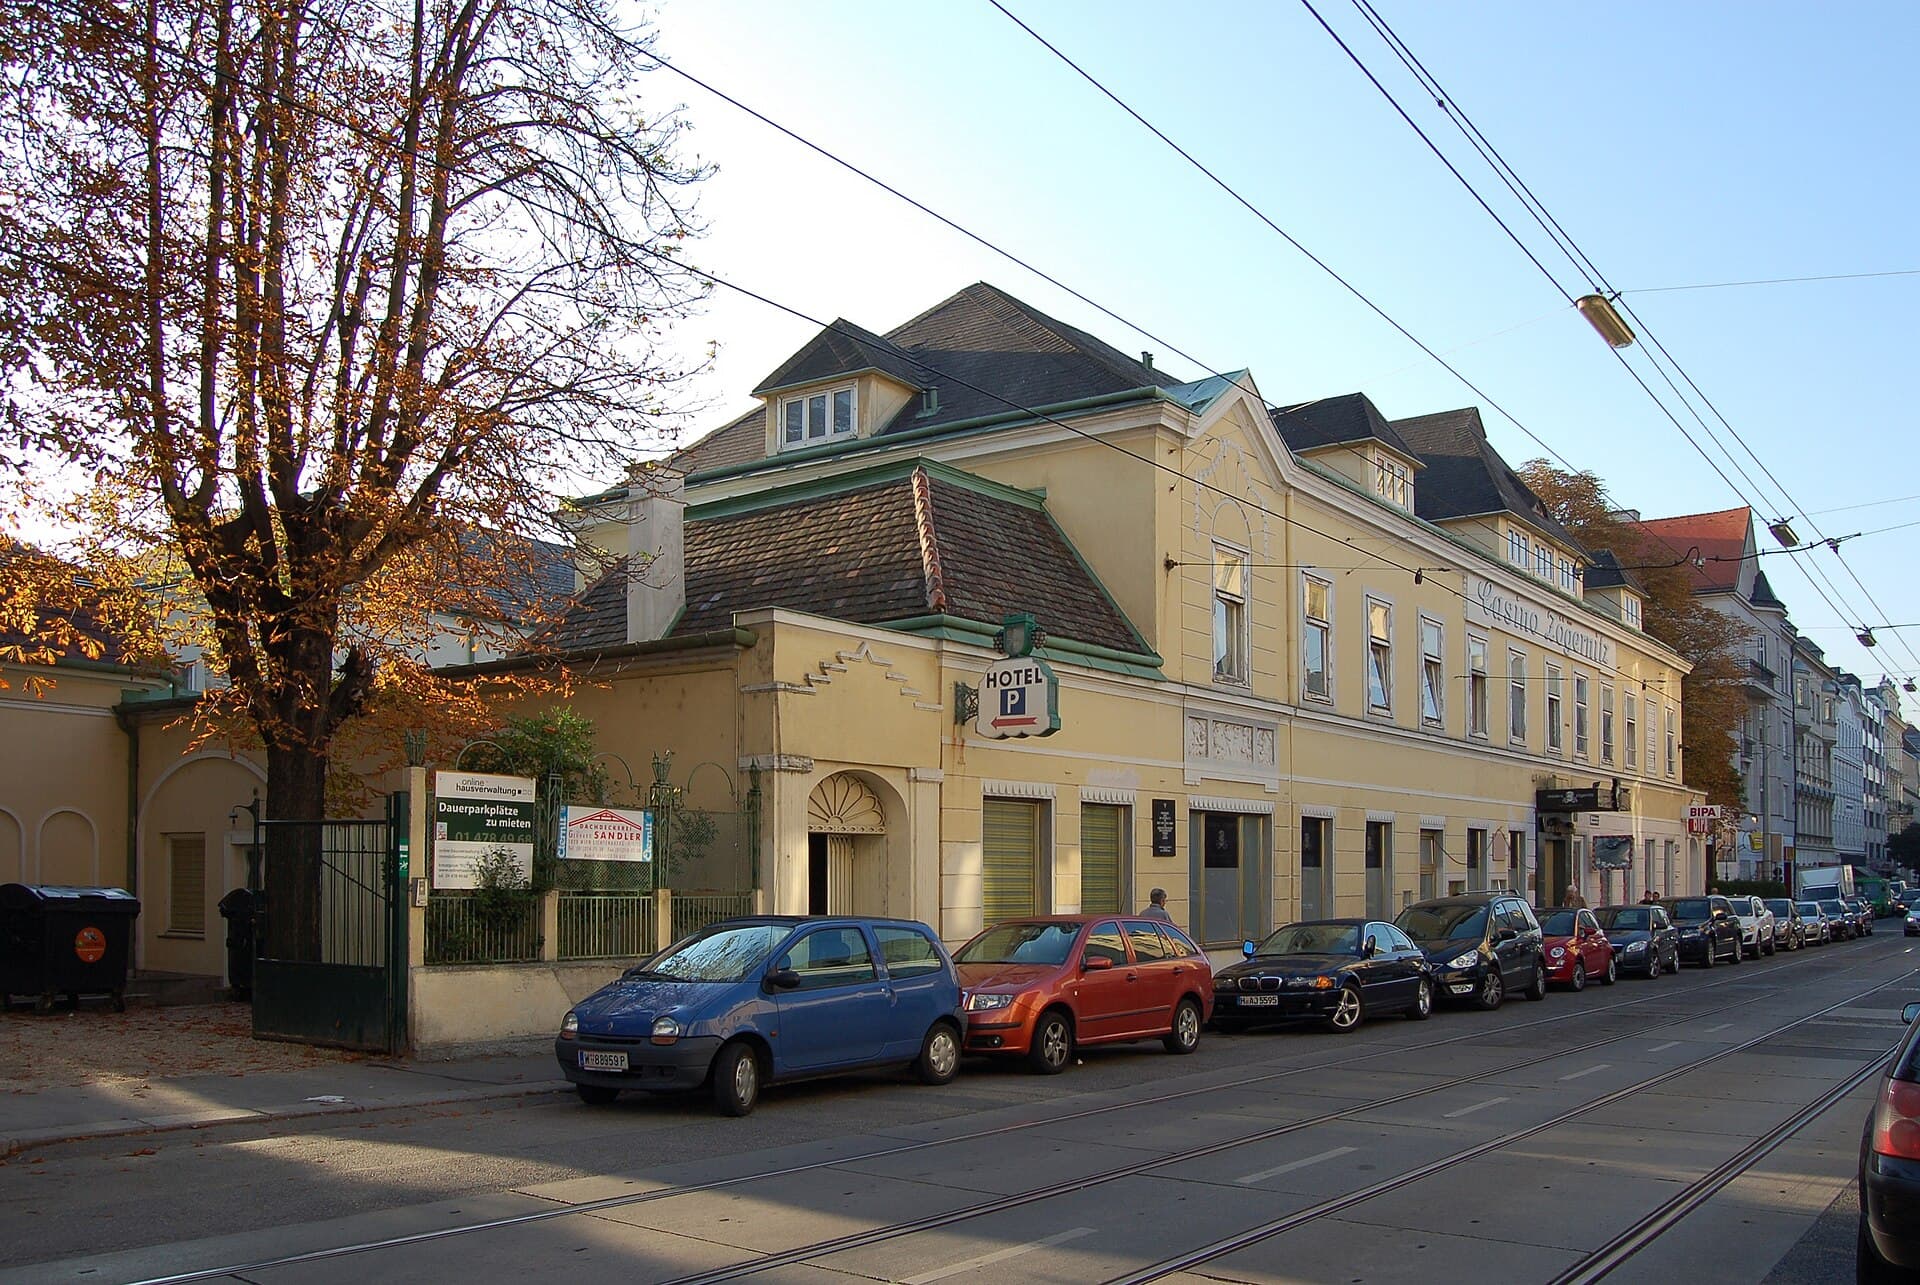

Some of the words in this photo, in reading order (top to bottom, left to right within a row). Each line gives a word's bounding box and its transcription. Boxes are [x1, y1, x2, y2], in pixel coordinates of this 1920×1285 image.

[1477, 581, 1538, 635] Casino
[1544, 610, 1608, 664] Zögernitz
[986, 668, 1043, 688] HOTEL
[1007, 690, 1020, 714] P
[461, 778, 485, 786] online
[456, 784, 517, 796] hausverwaltung
[439, 802, 519, 816] Dauerparkplätze
[1690, 807, 1716, 817] BIPA
[485, 818, 497, 827] zu
[499, 818, 531, 828] mieten
[455, 832, 469, 841] 01
[473, 832, 497, 842] 478
[594, 831, 641, 840] SANDLER
